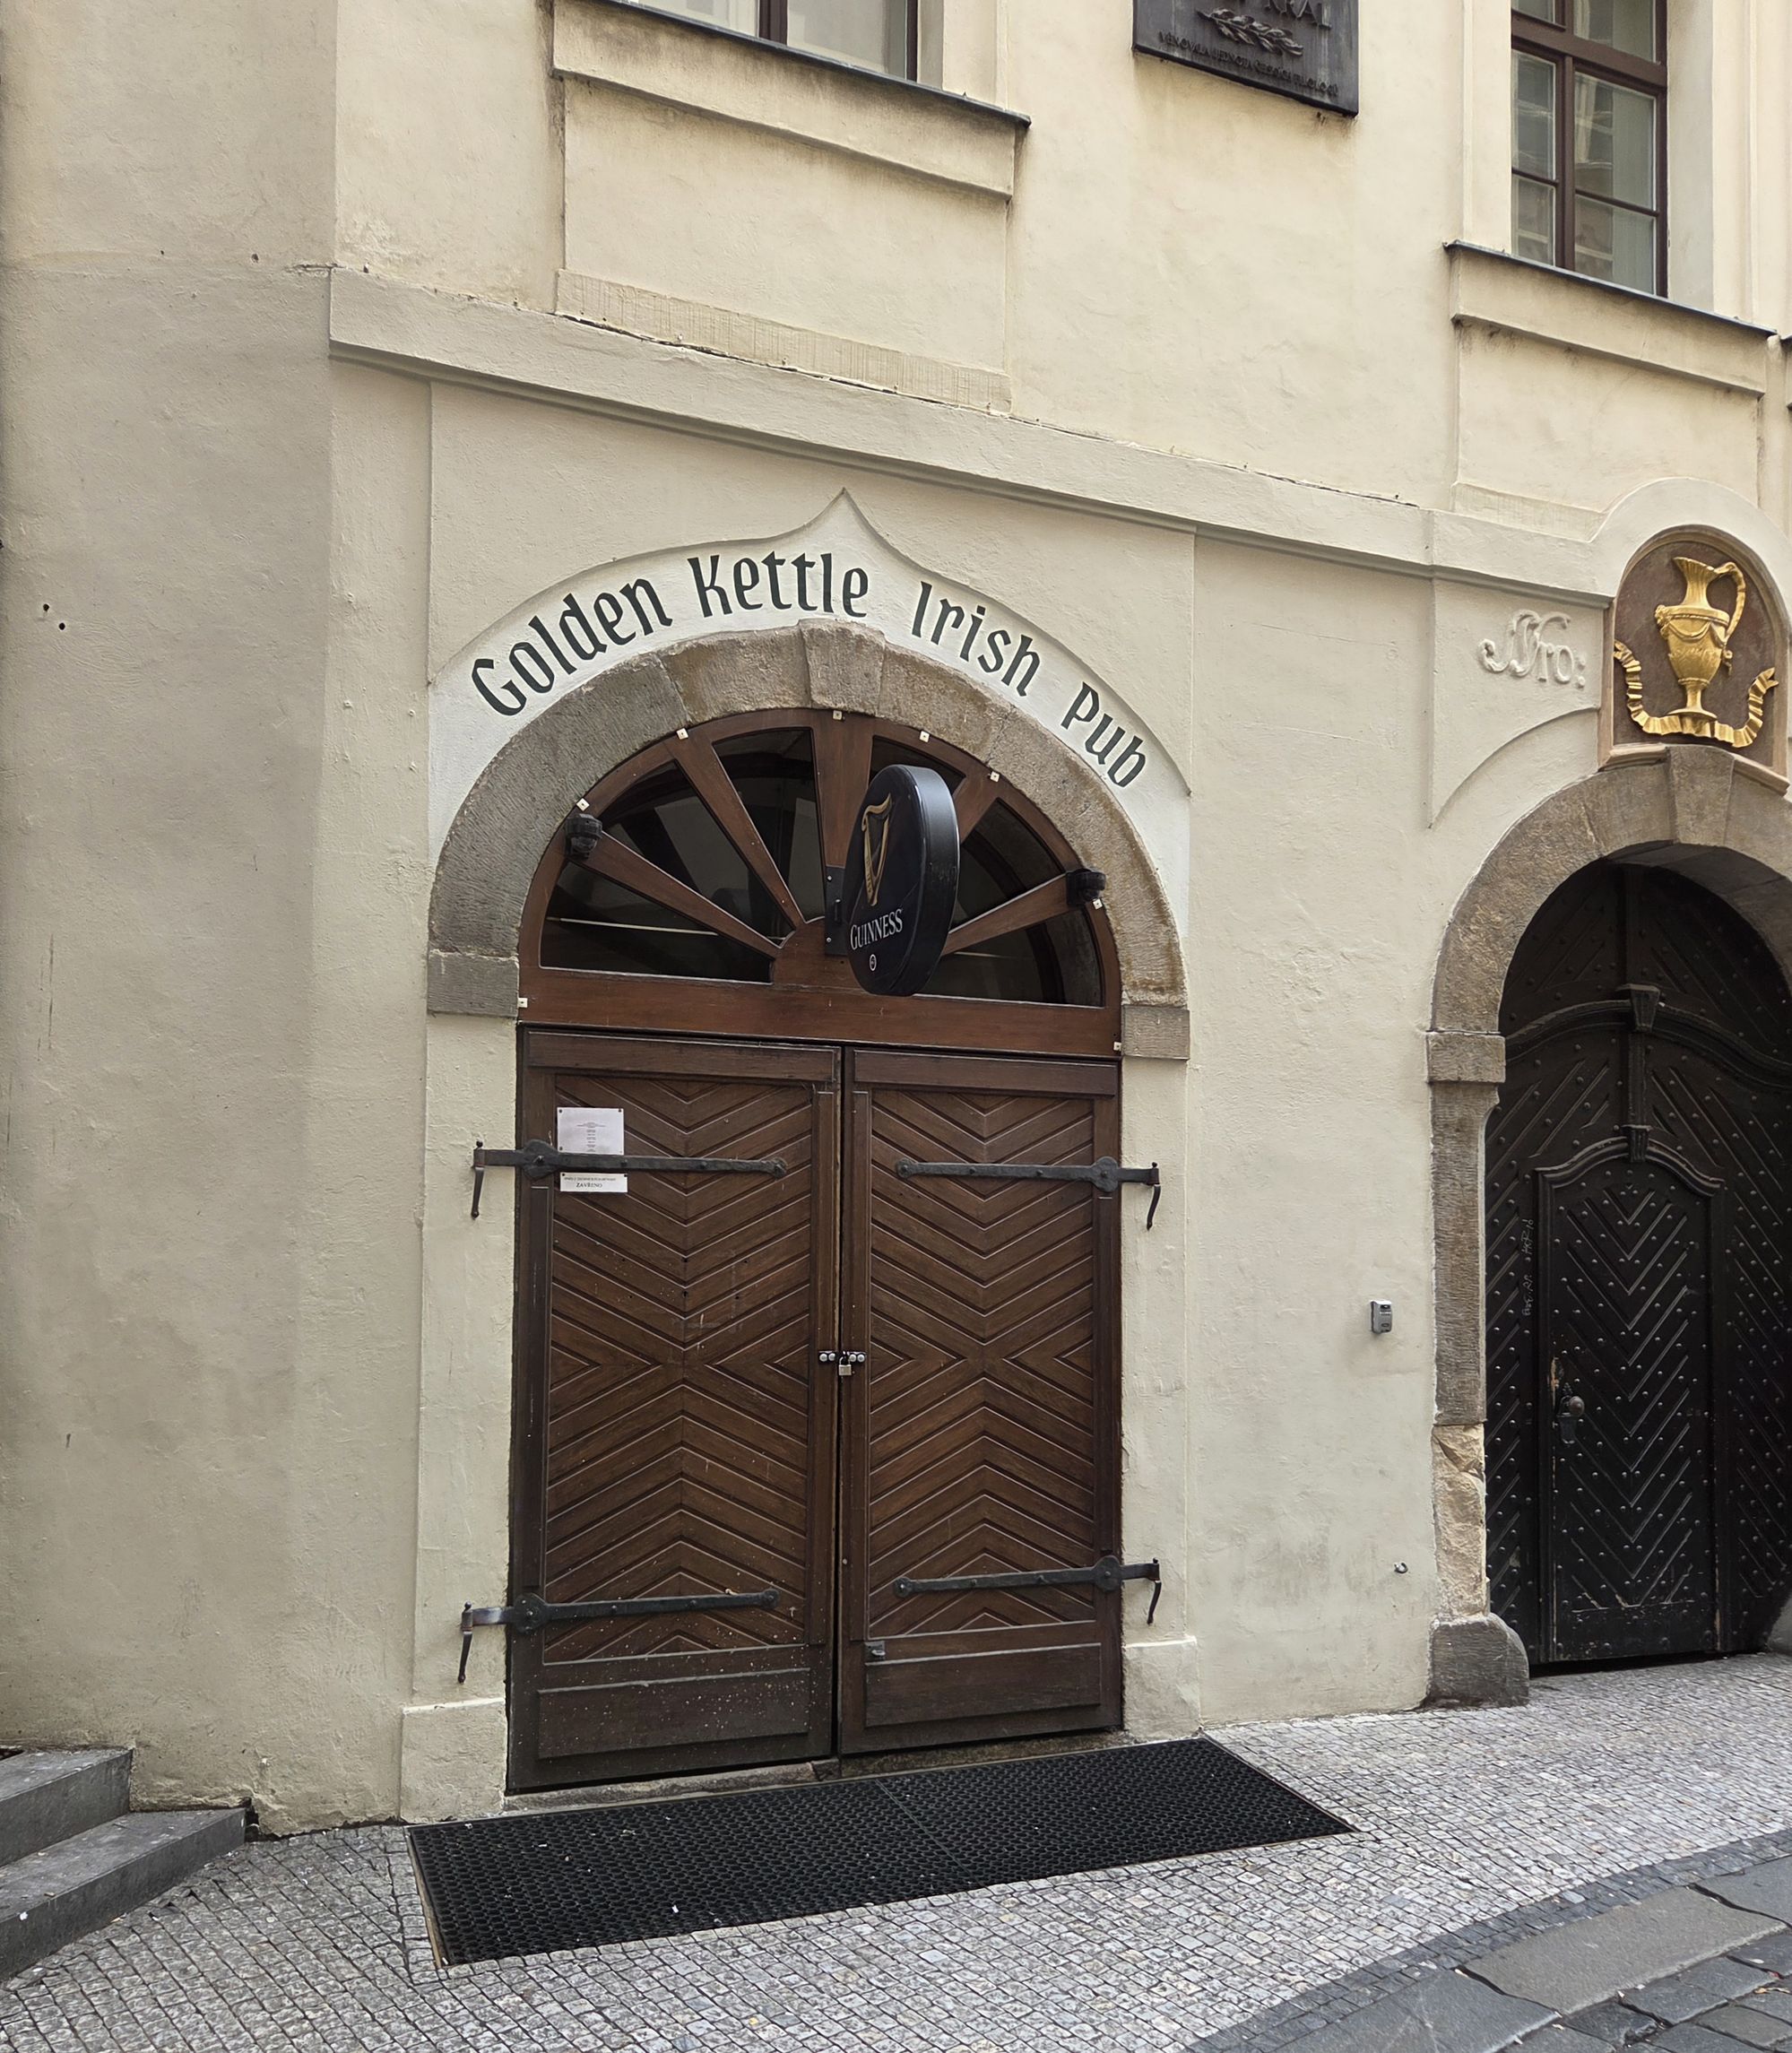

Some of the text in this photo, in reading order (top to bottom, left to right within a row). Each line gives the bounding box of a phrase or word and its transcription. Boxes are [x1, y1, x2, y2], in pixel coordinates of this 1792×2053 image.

[472, 552, 1147, 788] Golden Kettle Irish Pub
[850, 908, 904, 951] GUINNESS
